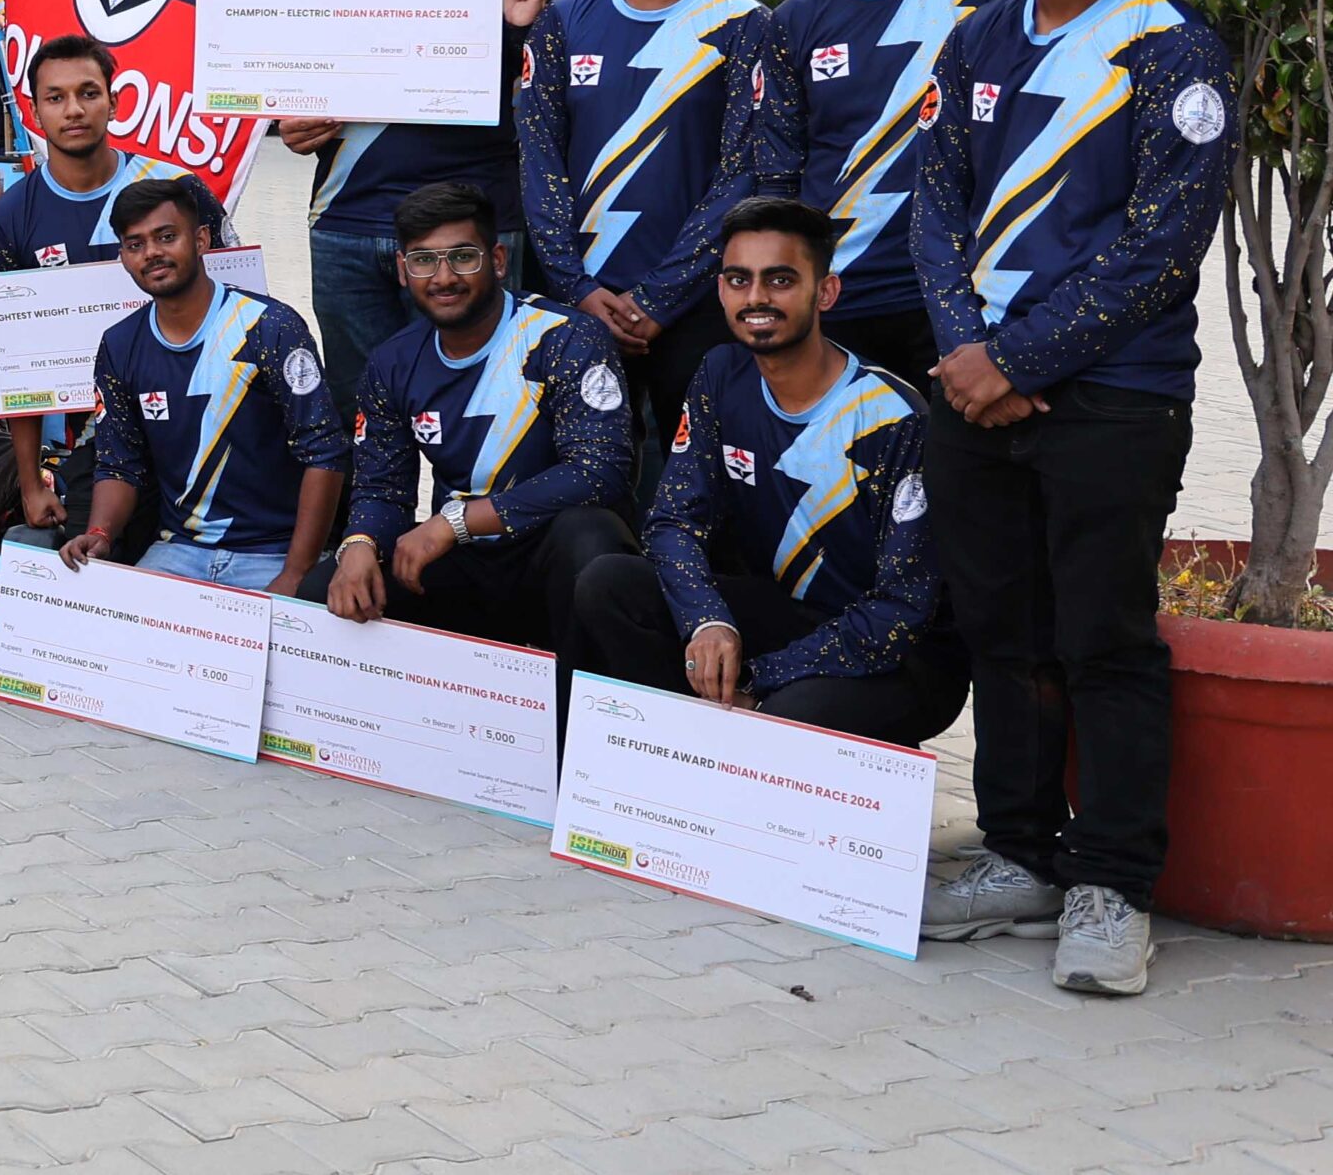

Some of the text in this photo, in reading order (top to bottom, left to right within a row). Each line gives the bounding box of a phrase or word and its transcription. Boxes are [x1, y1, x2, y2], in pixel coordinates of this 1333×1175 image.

[226, 9, 468, 19] CHAMPION ELECTRIC INDIAN KARTING RACE 2024
[433, 46, 467, 56] 60,000
[267, 62, 312, 70] THOUSAND
[314, 62, 334, 70] ONLY
[34, 308, 70, 319] WEIGHT
[79, 303, 121, 314] ELECTRIC
[122, 299, 152, 309] INDIA
[31, 356, 90, 368] FIVE THOUSAND
[0, 586, 263, 651] BEST COST AND MANUFACTURING INDIAN KARTING RACE 2024
[33, 648, 108, 673] FIVE THOUSAND ONLY
[202, 668, 228, 682] 5,000
[281, 645, 546, 711] ACCELERATION ELECTRIC INDIAN KARTING RACE 2024
[296, 705, 381, 732] FIVE THOUSAND ONLY
[486, 729, 515, 744] 5,000
[607, 734, 880, 811] ISIE FUTURE AWARD INDIAN KARTING RACE 2024
[572, 793, 715, 836] Rupees FIVE THOUSAND ONLY
[601, 846, 627, 860] INDIA
[848, 840, 883, 859] 5,000
[651, 856, 710, 879] GALGOTIAS
